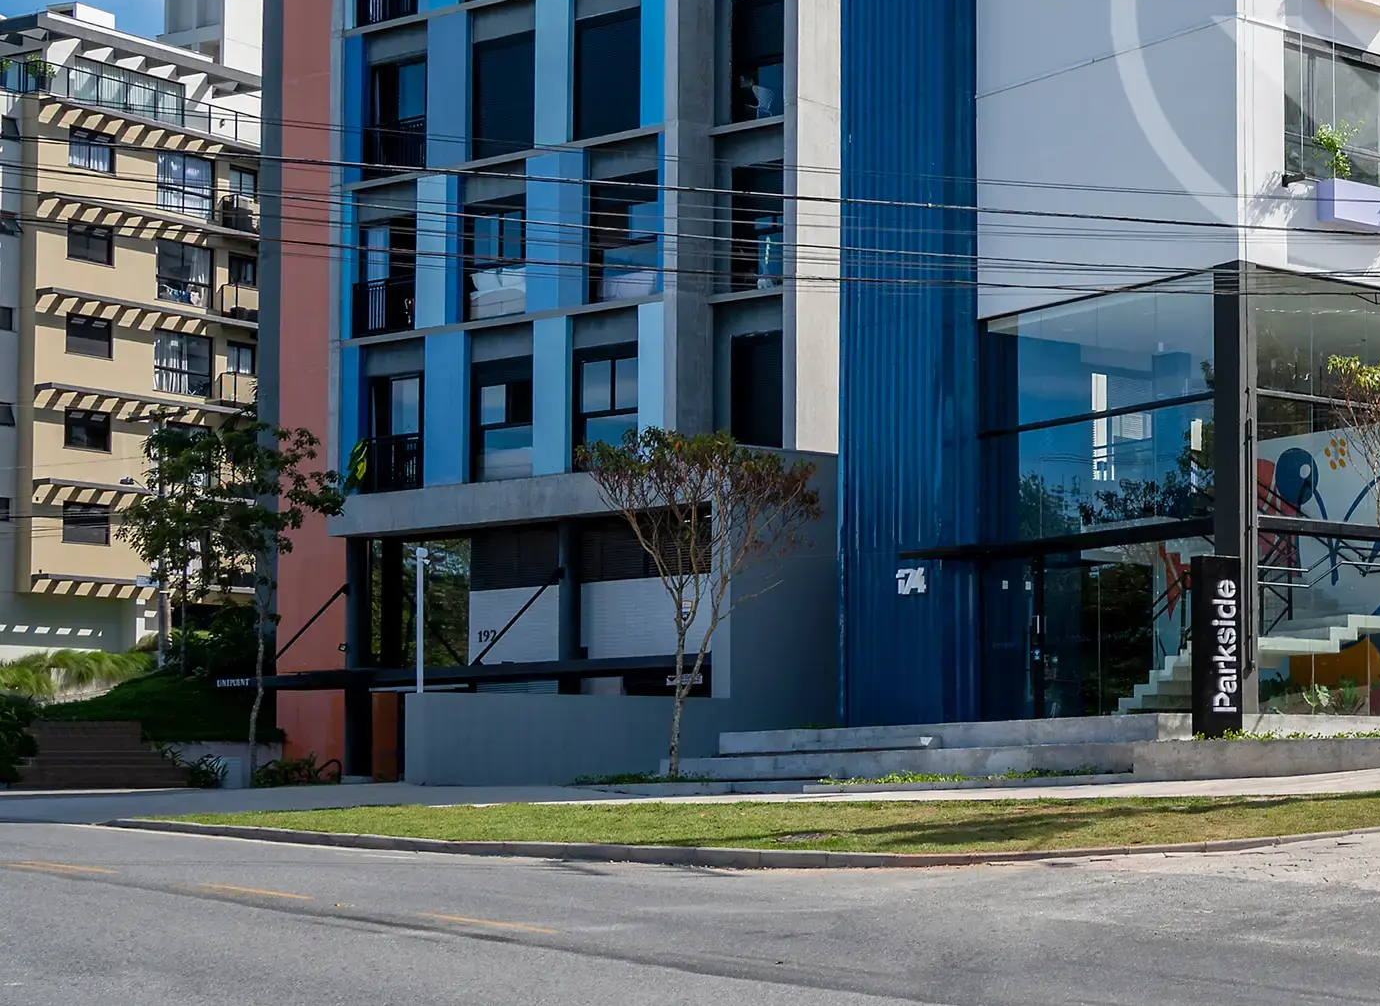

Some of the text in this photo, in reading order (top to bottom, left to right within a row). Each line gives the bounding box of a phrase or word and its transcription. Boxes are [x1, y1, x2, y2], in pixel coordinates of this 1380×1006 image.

[477, 629, 498, 643] 192
[1212, 579, 1238, 712] Parkside
[216, 678, 251, 687] UNIPOINT
